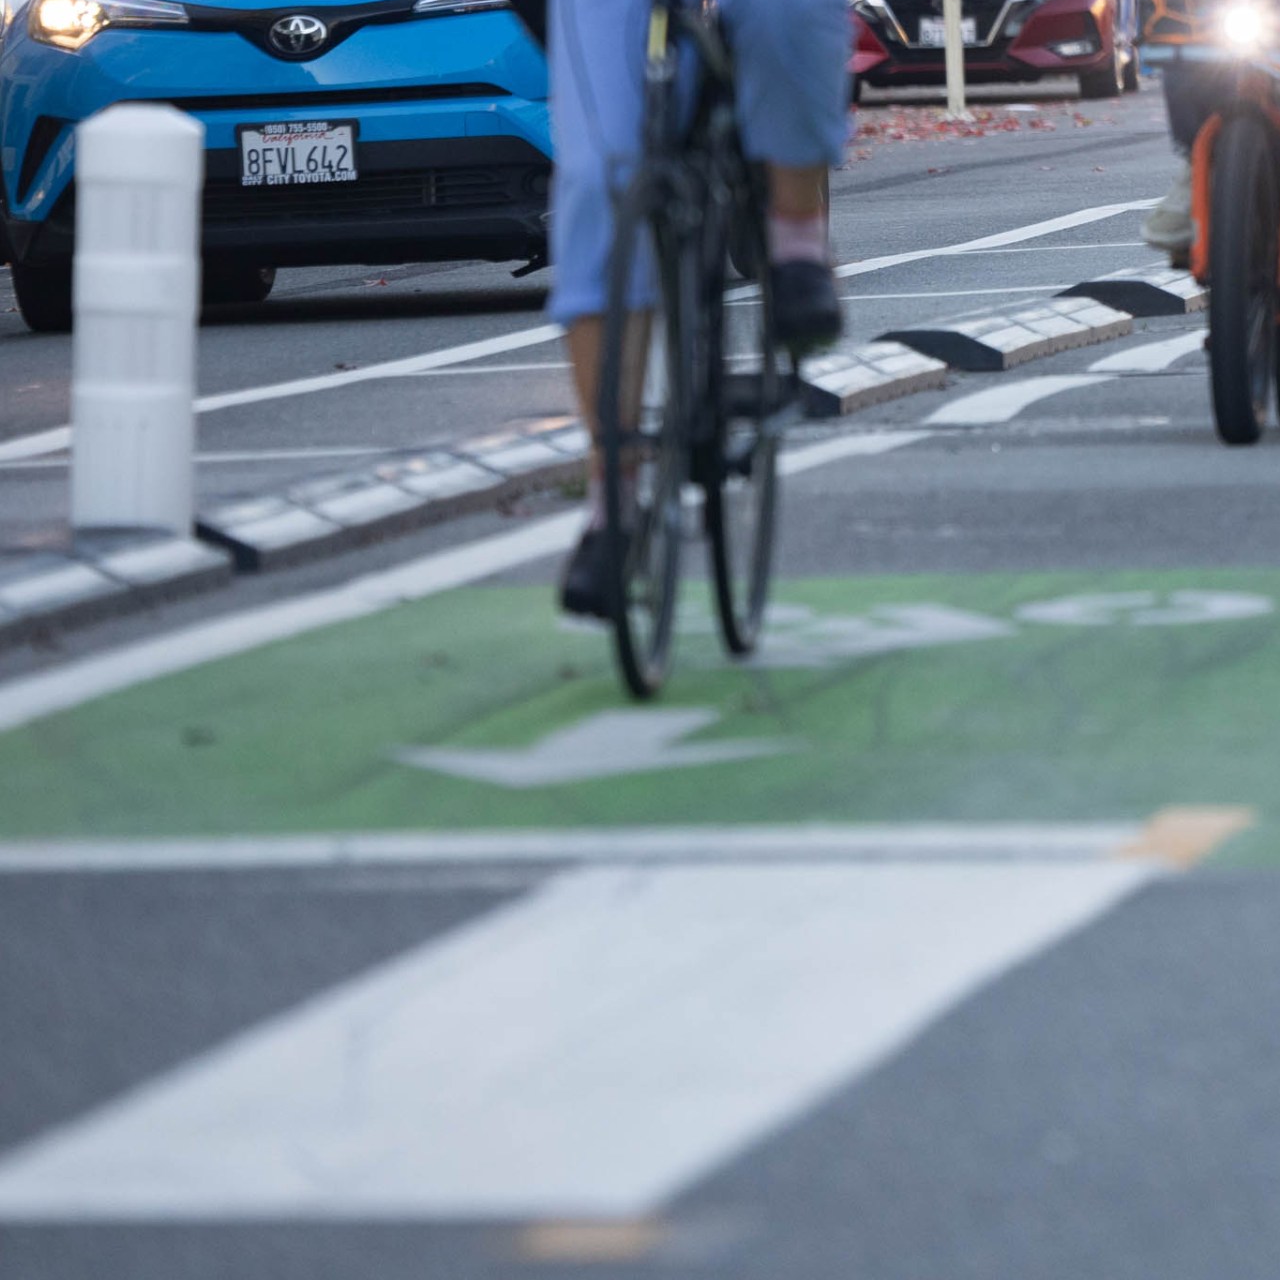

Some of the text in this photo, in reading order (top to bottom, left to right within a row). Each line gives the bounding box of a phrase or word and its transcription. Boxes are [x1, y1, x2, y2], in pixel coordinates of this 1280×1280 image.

[288, 122, 328, 132] 755-5500
[263, 131, 333, 145] California
[247, 144, 350, 175] 8FVL642
[267, 170, 357, 185] CITY TOYOTA.COM
